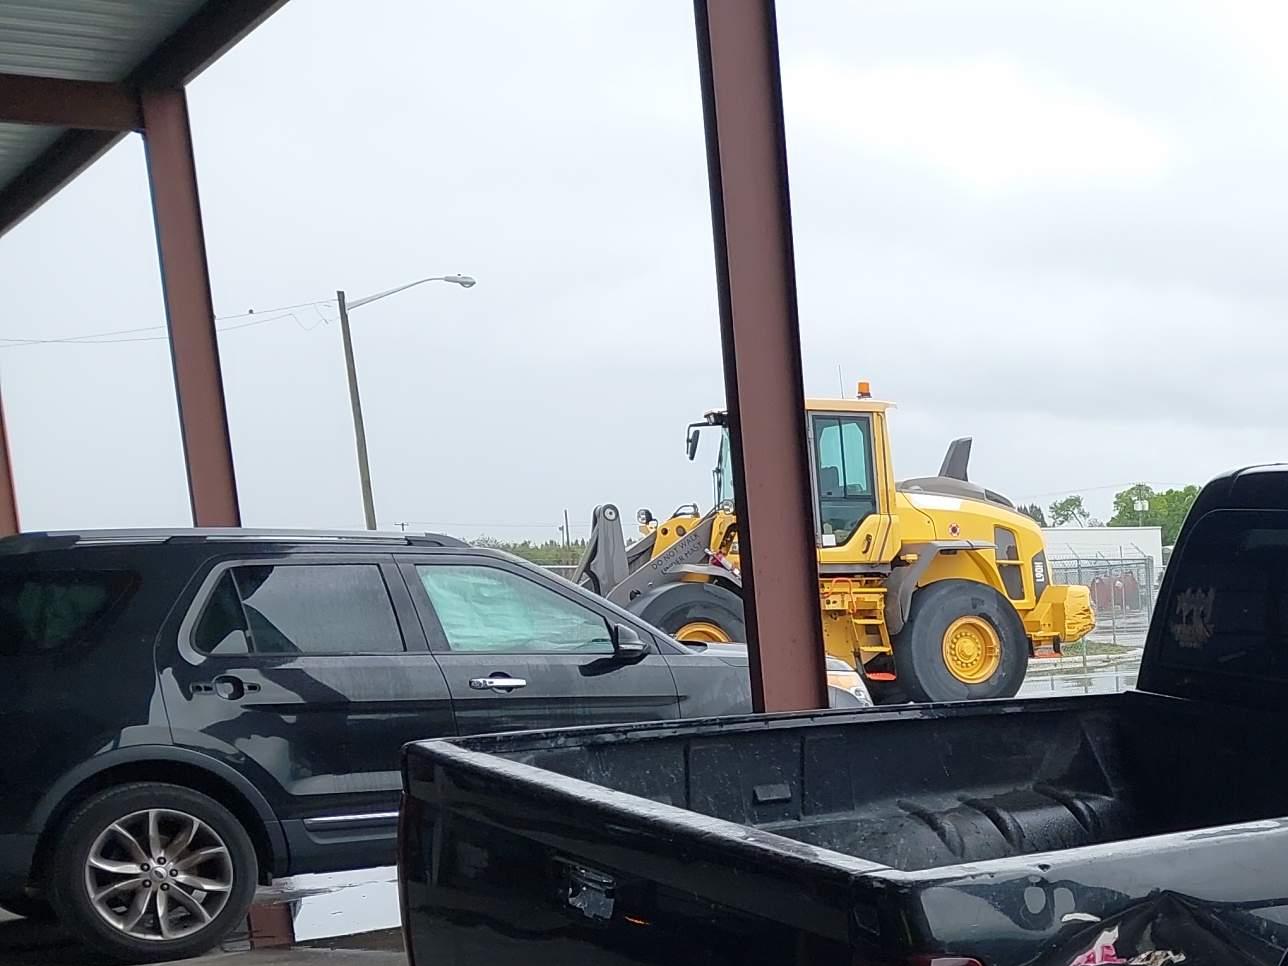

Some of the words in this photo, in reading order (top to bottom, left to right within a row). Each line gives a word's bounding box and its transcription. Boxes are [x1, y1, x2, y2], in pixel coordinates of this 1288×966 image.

[652, 559, 663, 569] DO
[664, 547, 679, 561] NOT
[680, 534, 699, 549] WALK
